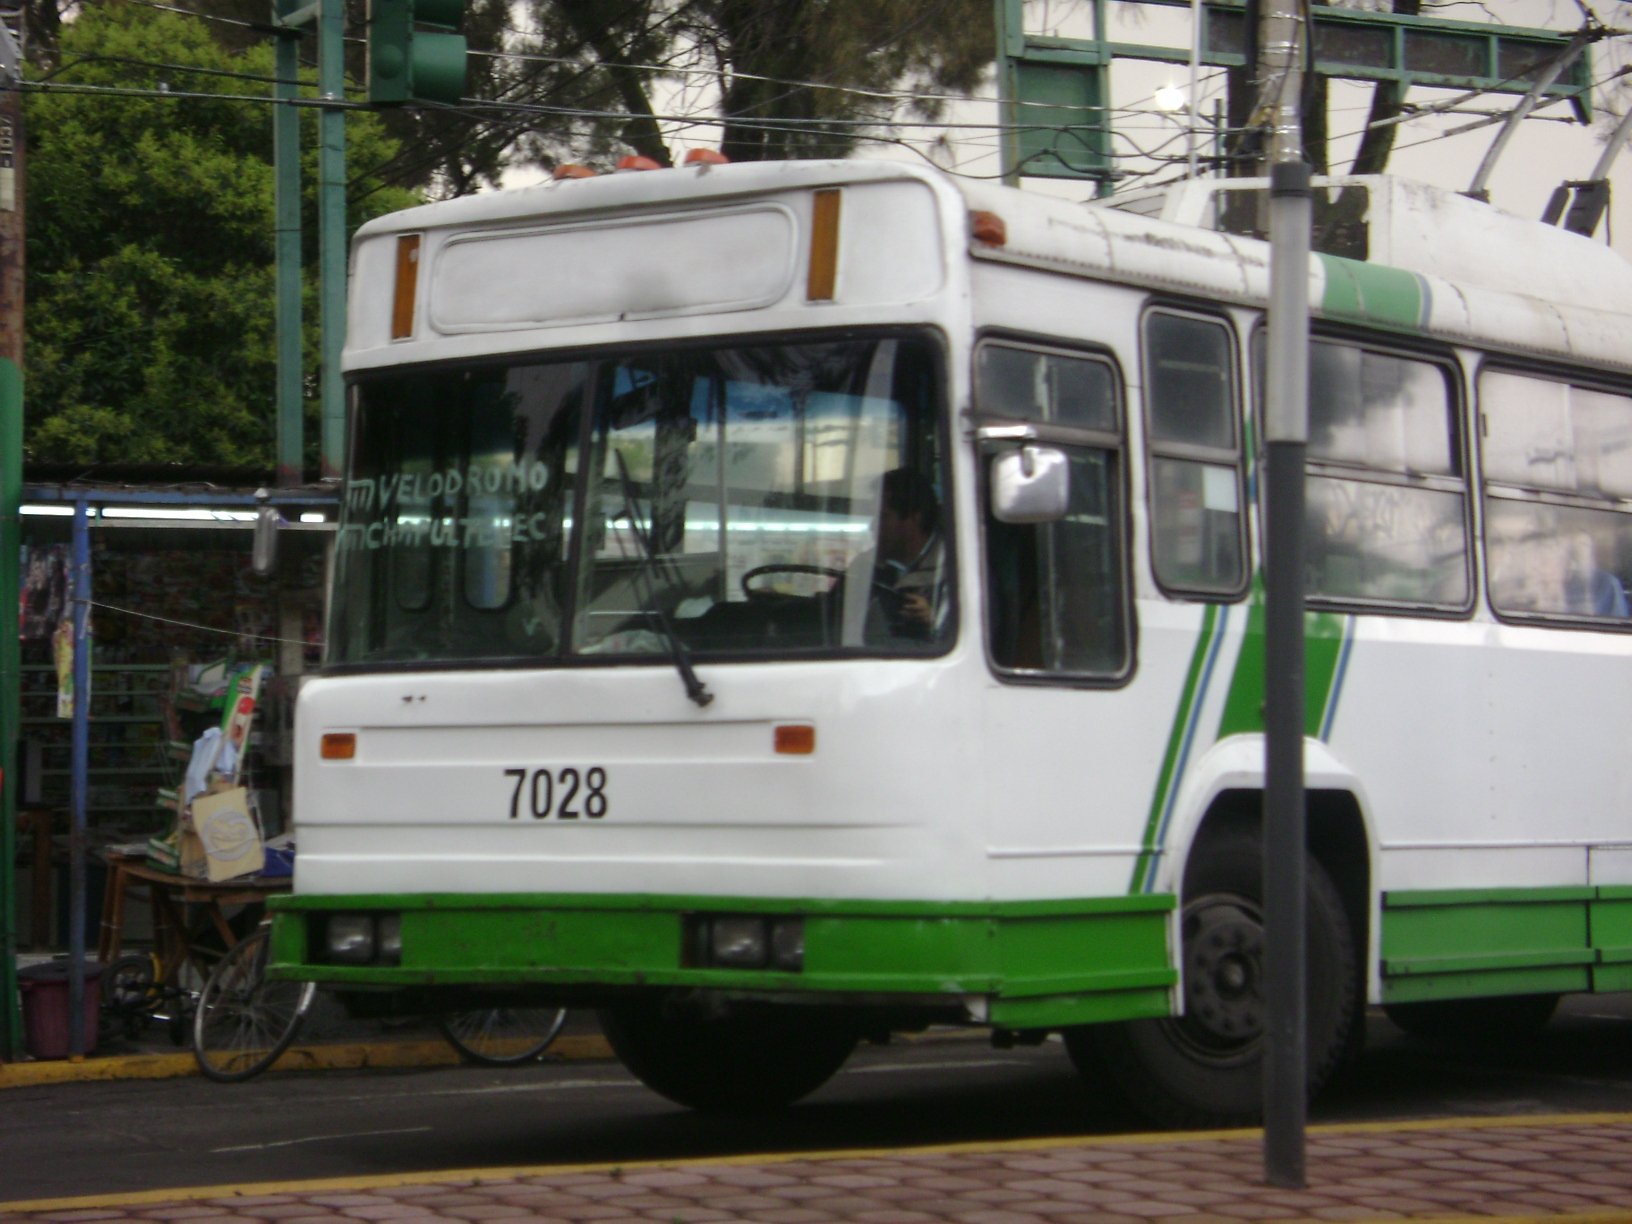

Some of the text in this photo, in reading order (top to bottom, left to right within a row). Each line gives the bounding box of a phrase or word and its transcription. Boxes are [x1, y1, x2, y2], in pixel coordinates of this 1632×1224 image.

[380, 459, 549, 511] VELODROMO
[366, 512, 547, 549] CHAPULTEEC
[504, 766, 608, 819] 7028
